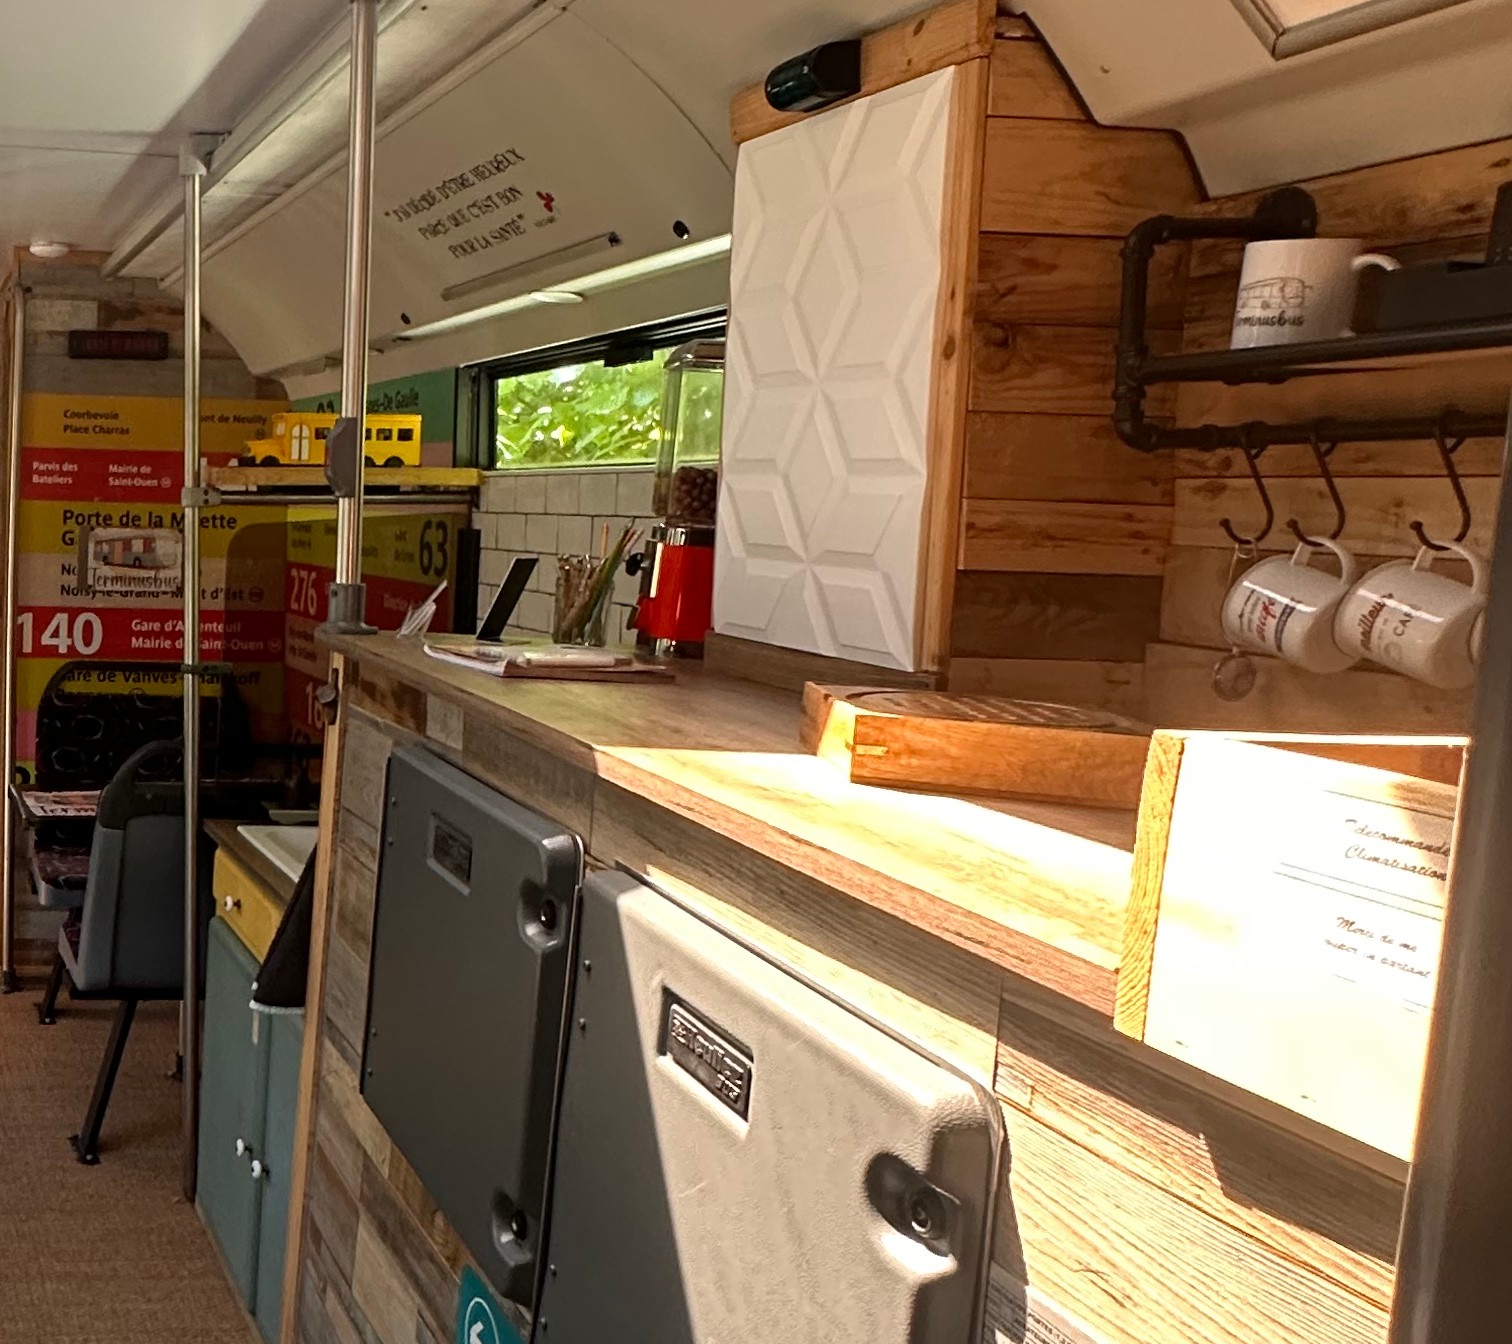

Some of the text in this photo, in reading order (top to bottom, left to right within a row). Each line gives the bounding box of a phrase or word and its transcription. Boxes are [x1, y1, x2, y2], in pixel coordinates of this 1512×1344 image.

[470, 148, 525, 181] HEUREUX
[418, 217, 449, 240] PARCE
[447, 207, 470, 228] QUE
[499, 185, 523, 206] BON
[448, 237, 478, 259] POUR
[476, 231, 493, 249] LA
[63, 410, 119, 421] Courbevoie
[217, 413, 230, 423] de
[233, 414, 268, 426] Neuilly
[63, 424, 130, 436] Place Charras
[32, 462, 78, 472] Parvis des
[109, 464, 152, 475] Mairie de
[32, 474, 72, 485] Bateliers
[108, 476, 158, 488] Saint-Ouen
[63, 509, 237, 530] Porte de la Mette
[419, 519, 449, 578] 63
[290, 568, 318, 616] 276
[131, 619, 241, 633] Gare d'Anteuil
[16, 612, 103, 655] 140
[131, 637, 172, 650] Mairie
[97, 670, 117, 683] de
[123, 670, 177, 684] Vanves
[1380, 934, 1394, 945] de
[1399, 942, 1418, 953] me
